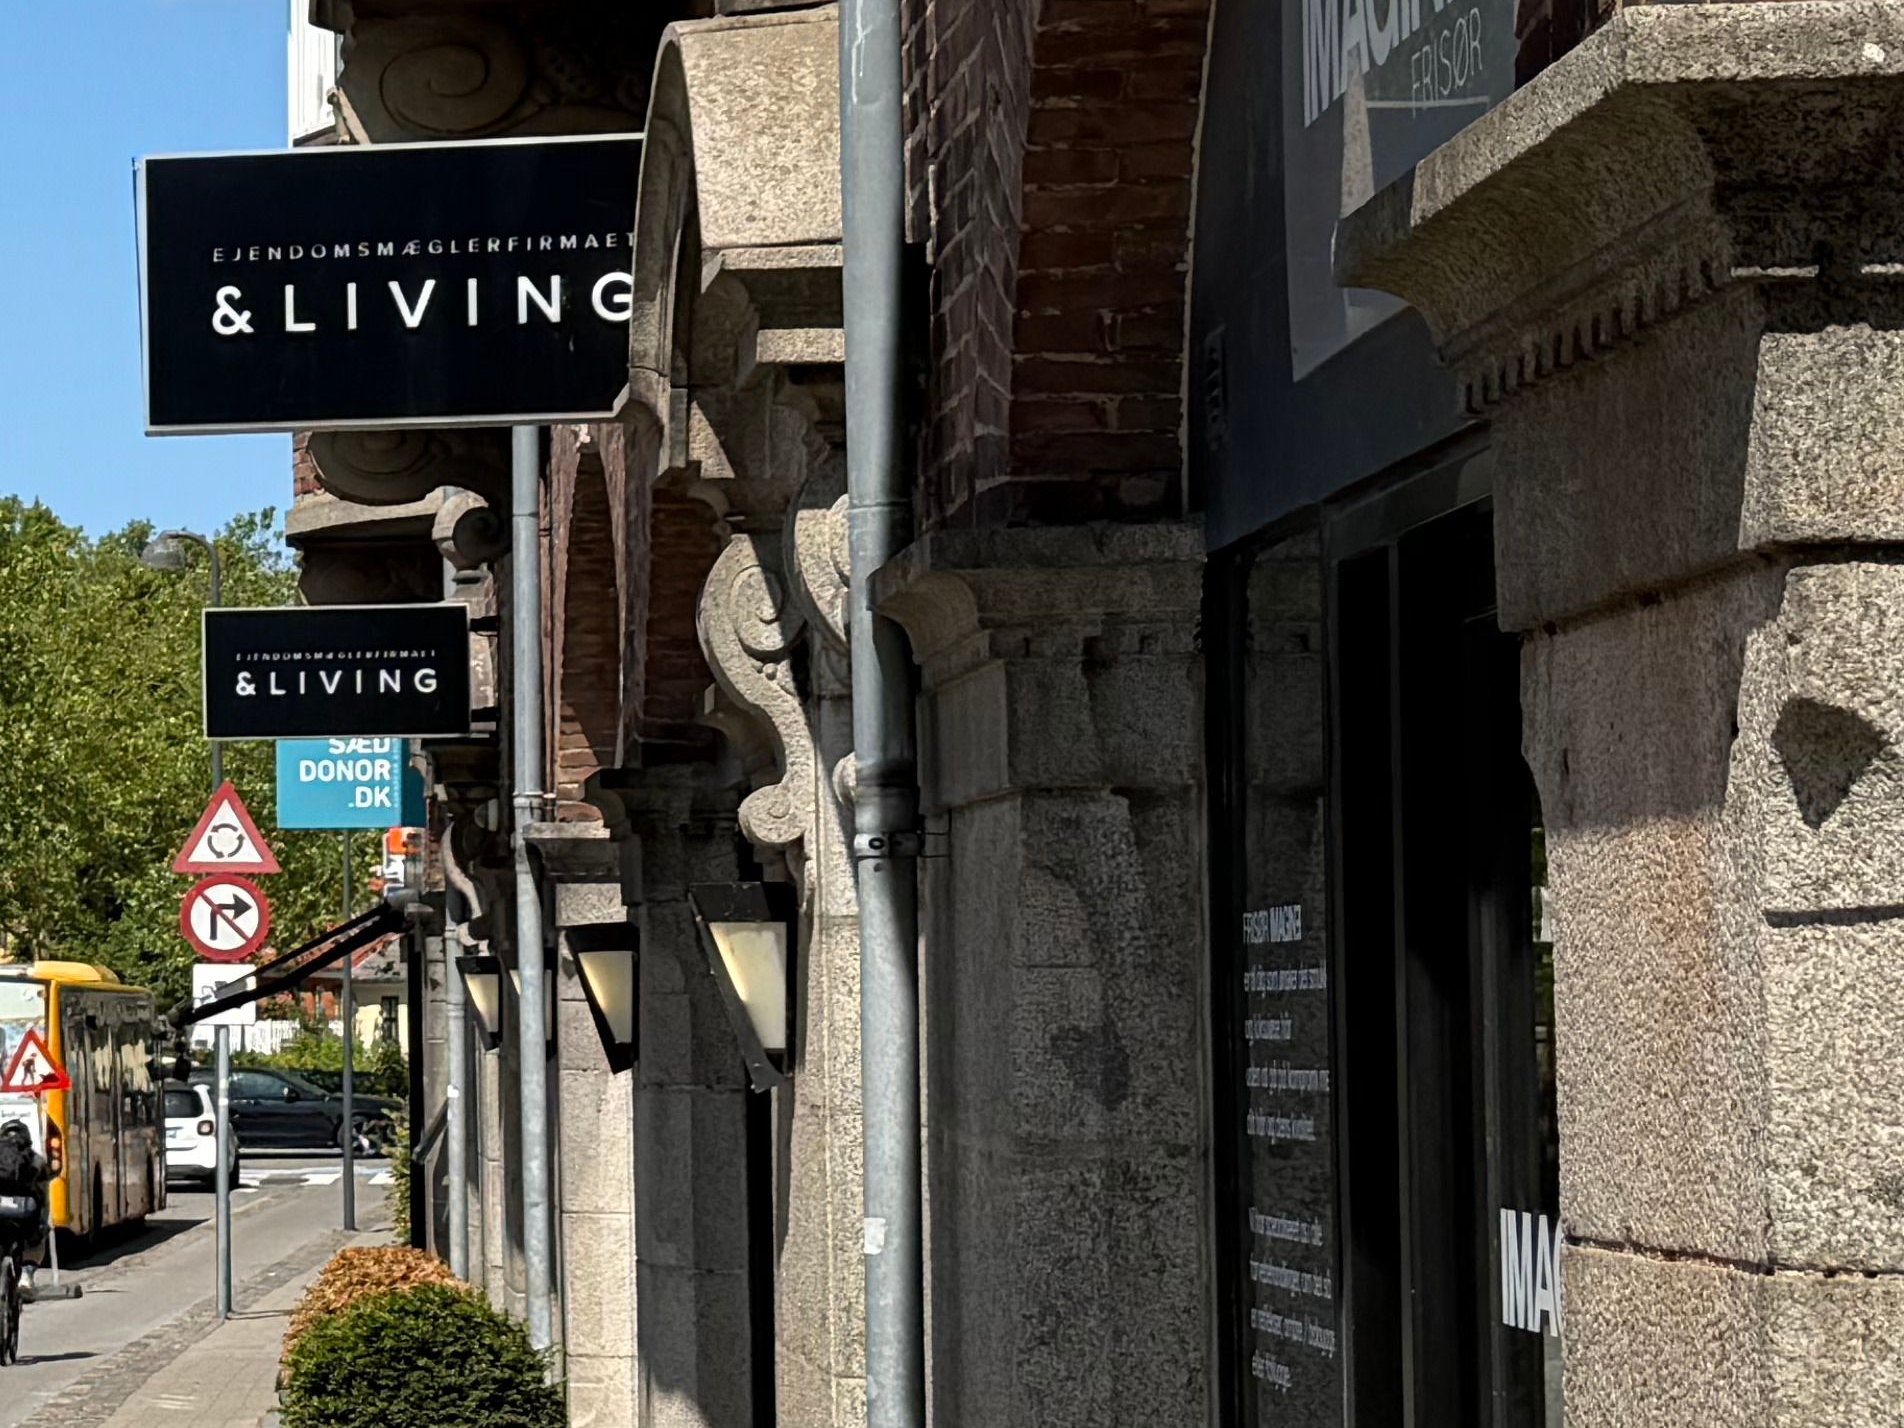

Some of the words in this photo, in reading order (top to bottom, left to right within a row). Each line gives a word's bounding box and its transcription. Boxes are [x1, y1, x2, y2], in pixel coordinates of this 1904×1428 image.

[1411, 7, 1483, 119] FRISØR
[299, 759, 392, 783] DONOR
[348, 785, 392, 809] .DK
